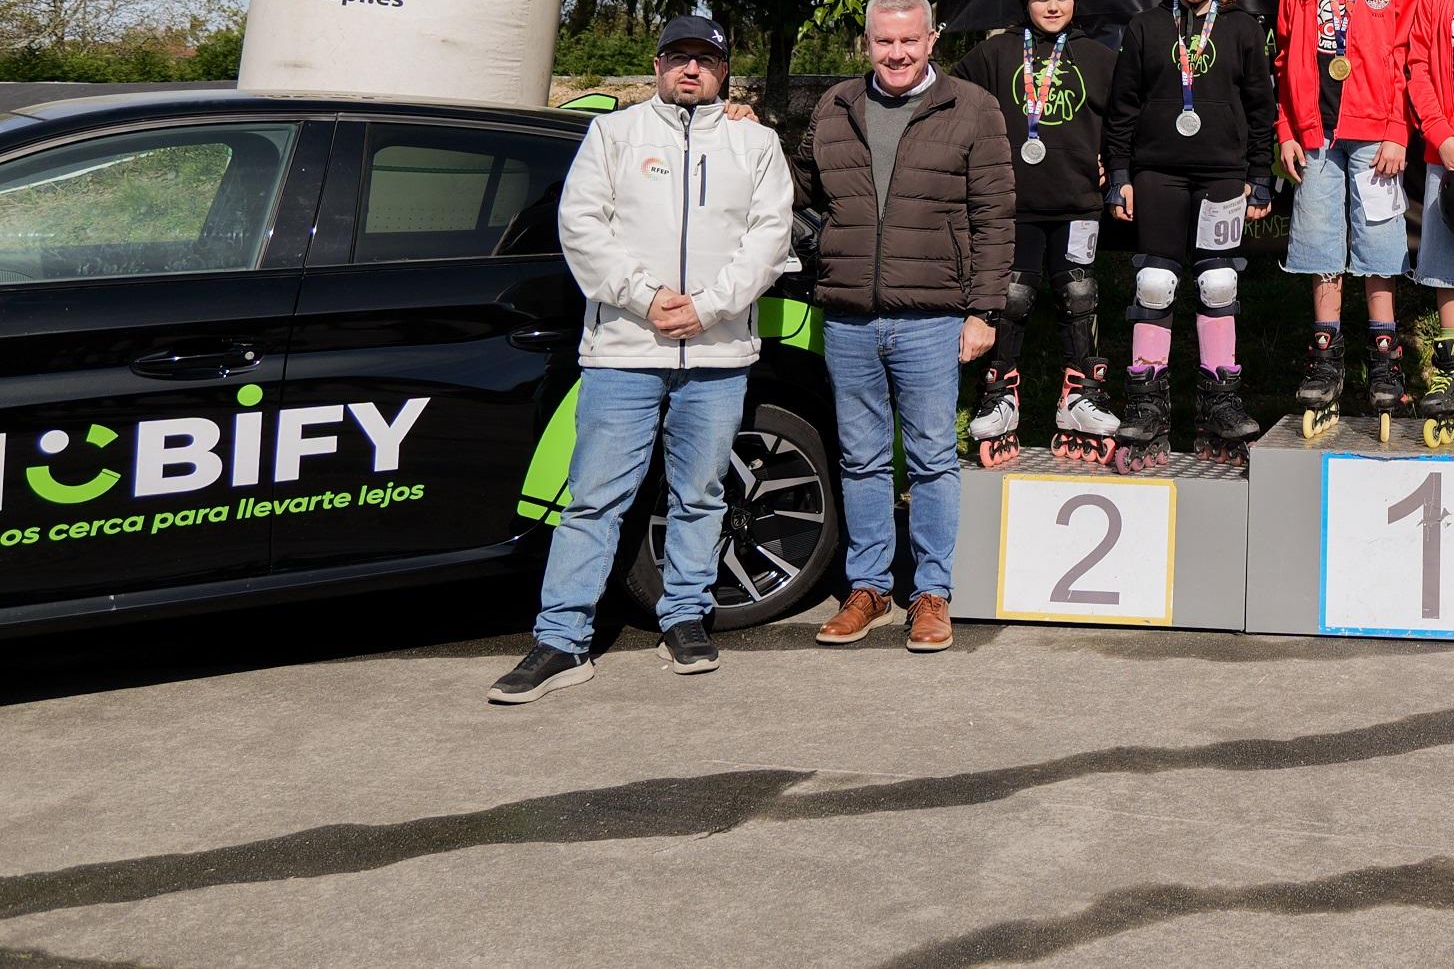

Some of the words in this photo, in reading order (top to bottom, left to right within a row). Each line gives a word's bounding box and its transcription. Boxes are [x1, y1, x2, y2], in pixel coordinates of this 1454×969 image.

[1214, 217, 1241, 245] 90
[0, 526, 41, 546] os
[49, 515, 144, 541] cerca
[151, 504, 230, 535] para
[237, 487, 351, 518] llevarte
[358, 480, 425, 508] lejos
[1049, 493, 1123, 605] 2
[1387, 471, 1442, 621] 1
